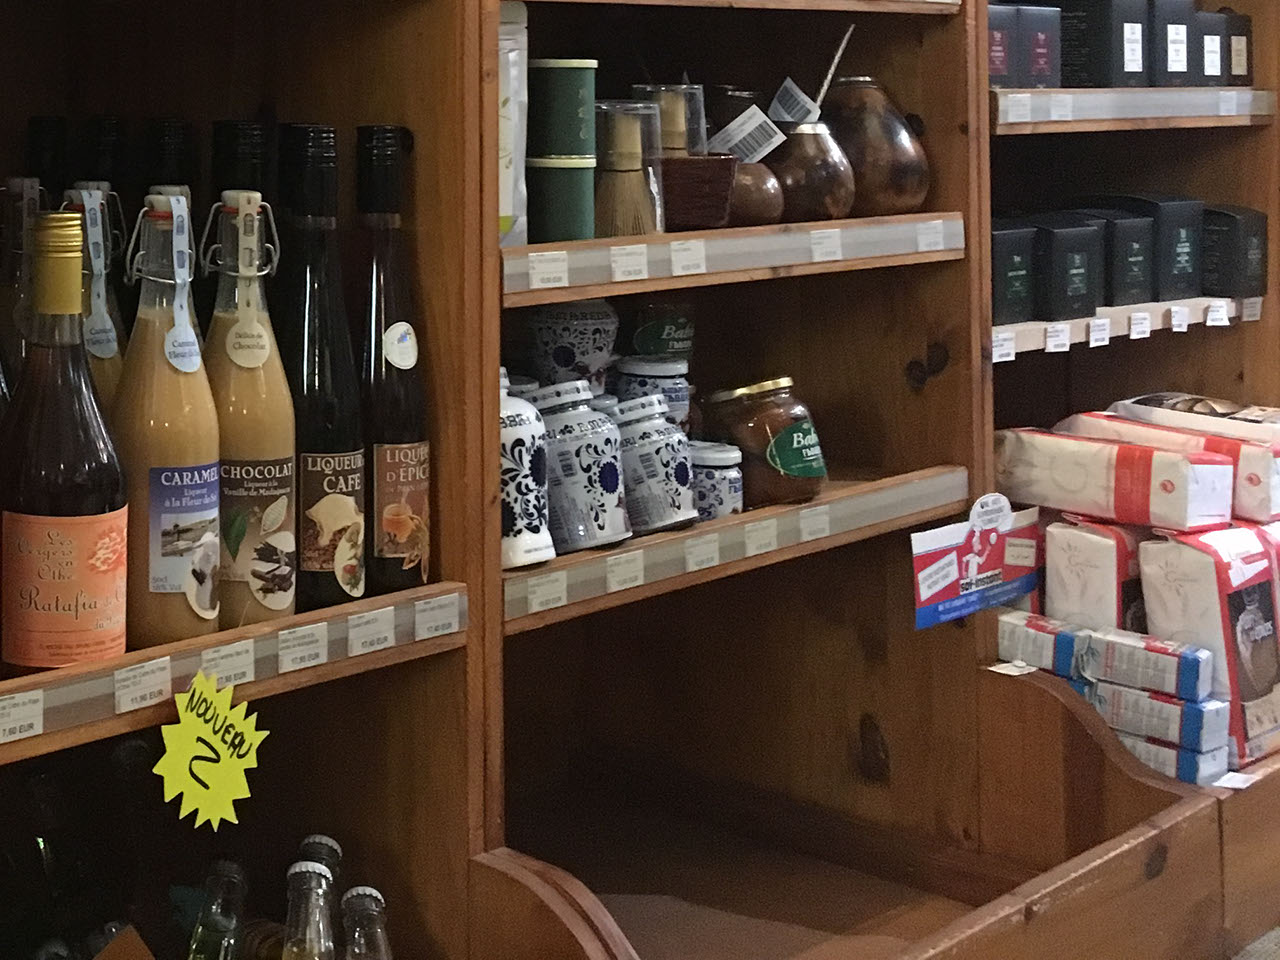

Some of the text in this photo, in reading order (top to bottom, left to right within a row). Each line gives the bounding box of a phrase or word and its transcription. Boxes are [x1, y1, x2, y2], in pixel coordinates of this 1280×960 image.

[161, 467, 219, 487] CARAMEL
[221, 462, 293, 479] CHOCOLAT
[46, 529, 73, 546] Les
[20, 587, 98, 620] Ratafia
[234, 671, 247, 681] EUR
[149, 689, 164, 700] EUR
[19, 723, 35, 734] EUR
[185, 687, 253, 759] NOUVEAU
